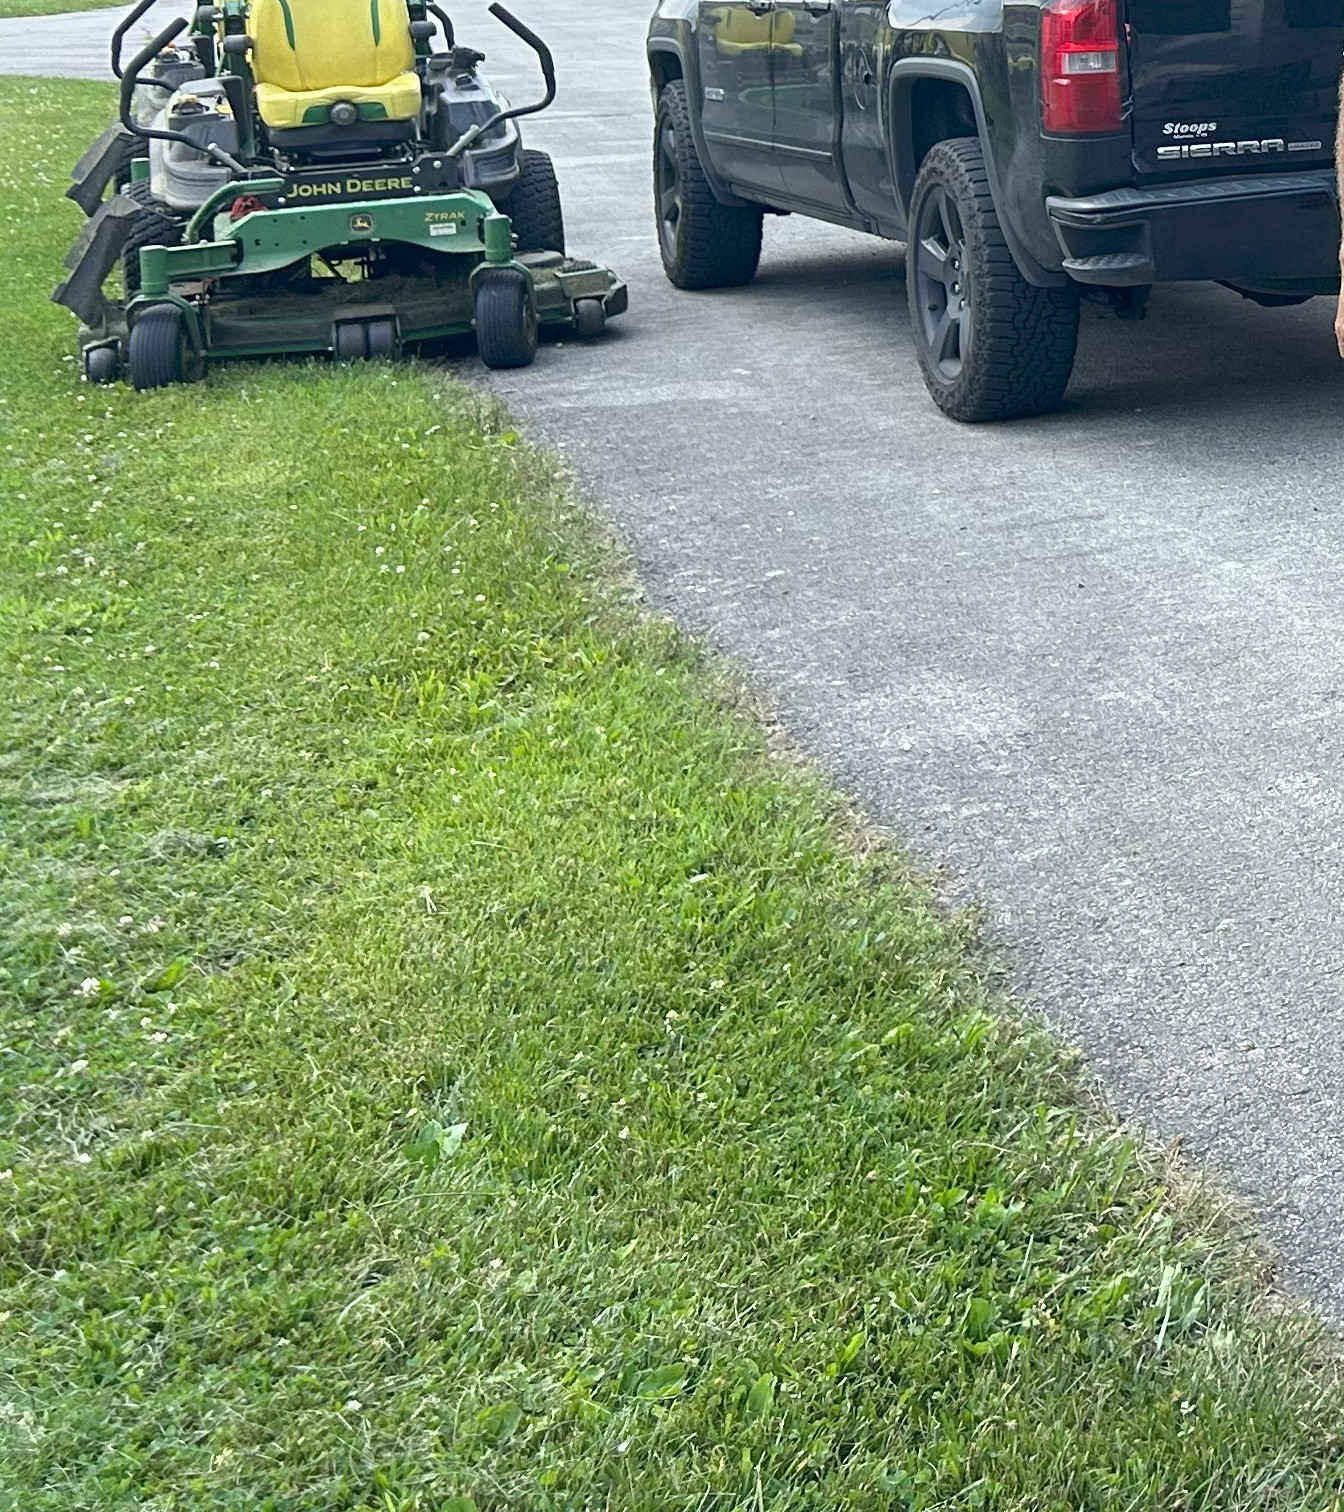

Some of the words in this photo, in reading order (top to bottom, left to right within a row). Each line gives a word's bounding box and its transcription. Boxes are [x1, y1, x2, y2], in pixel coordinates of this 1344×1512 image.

[1162, 122, 1218, 135] Stoops
[1156, 138, 1285, 160] SIERRA
[286, 181, 342, 199] JOHN
[346, 175, 414, 194] DEERE
